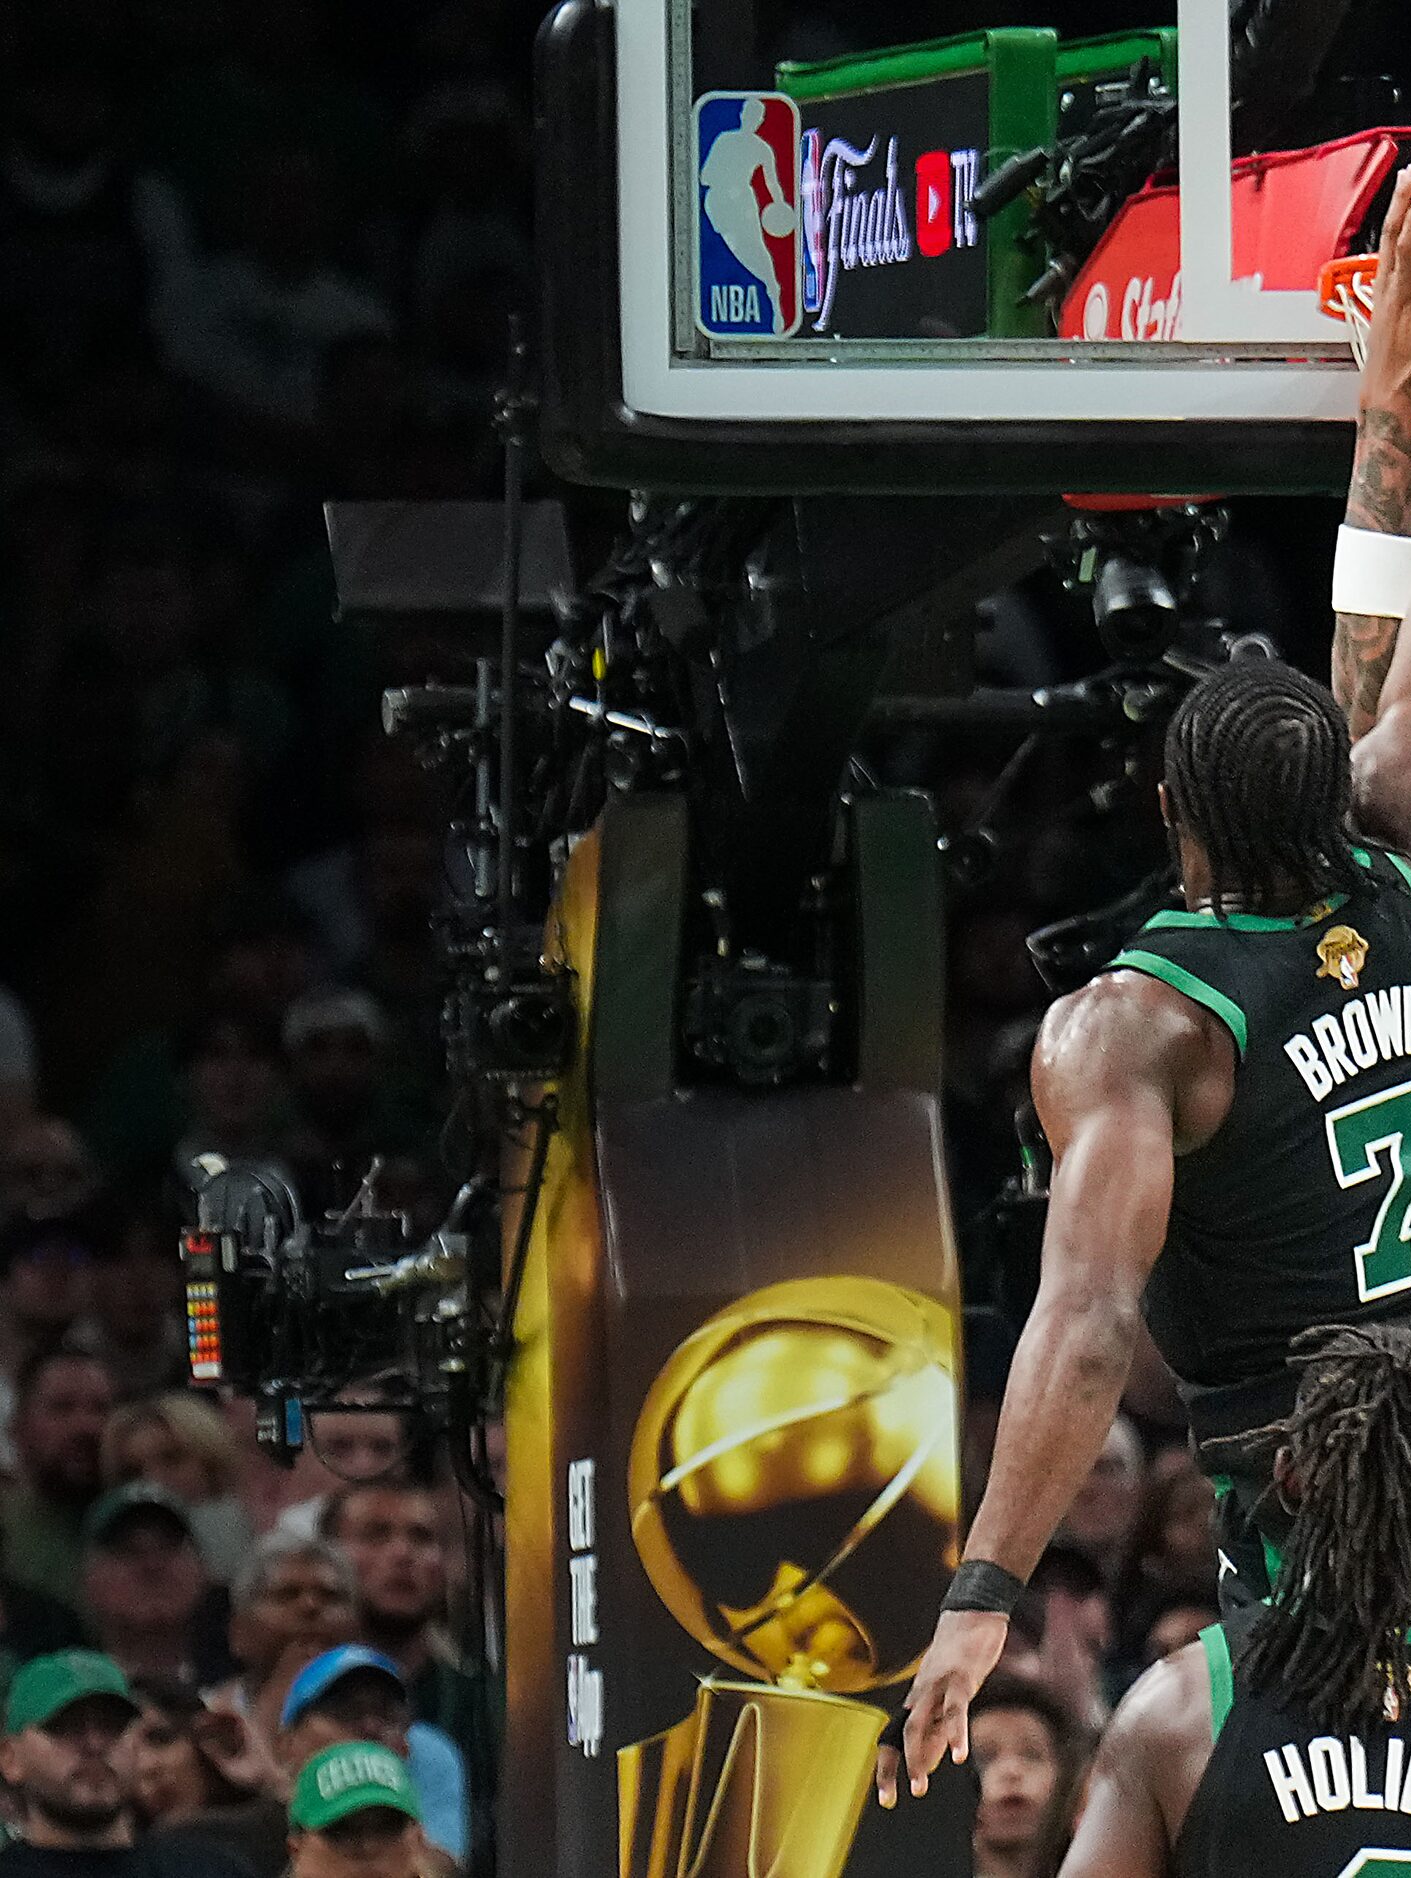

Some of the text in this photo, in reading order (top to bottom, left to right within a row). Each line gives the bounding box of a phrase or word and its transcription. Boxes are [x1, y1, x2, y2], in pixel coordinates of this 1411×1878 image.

[812, 133, 910, 332] Finals
[710, 284, 762, 324] NBA
[1121, 270, 1184, 341] Stat
